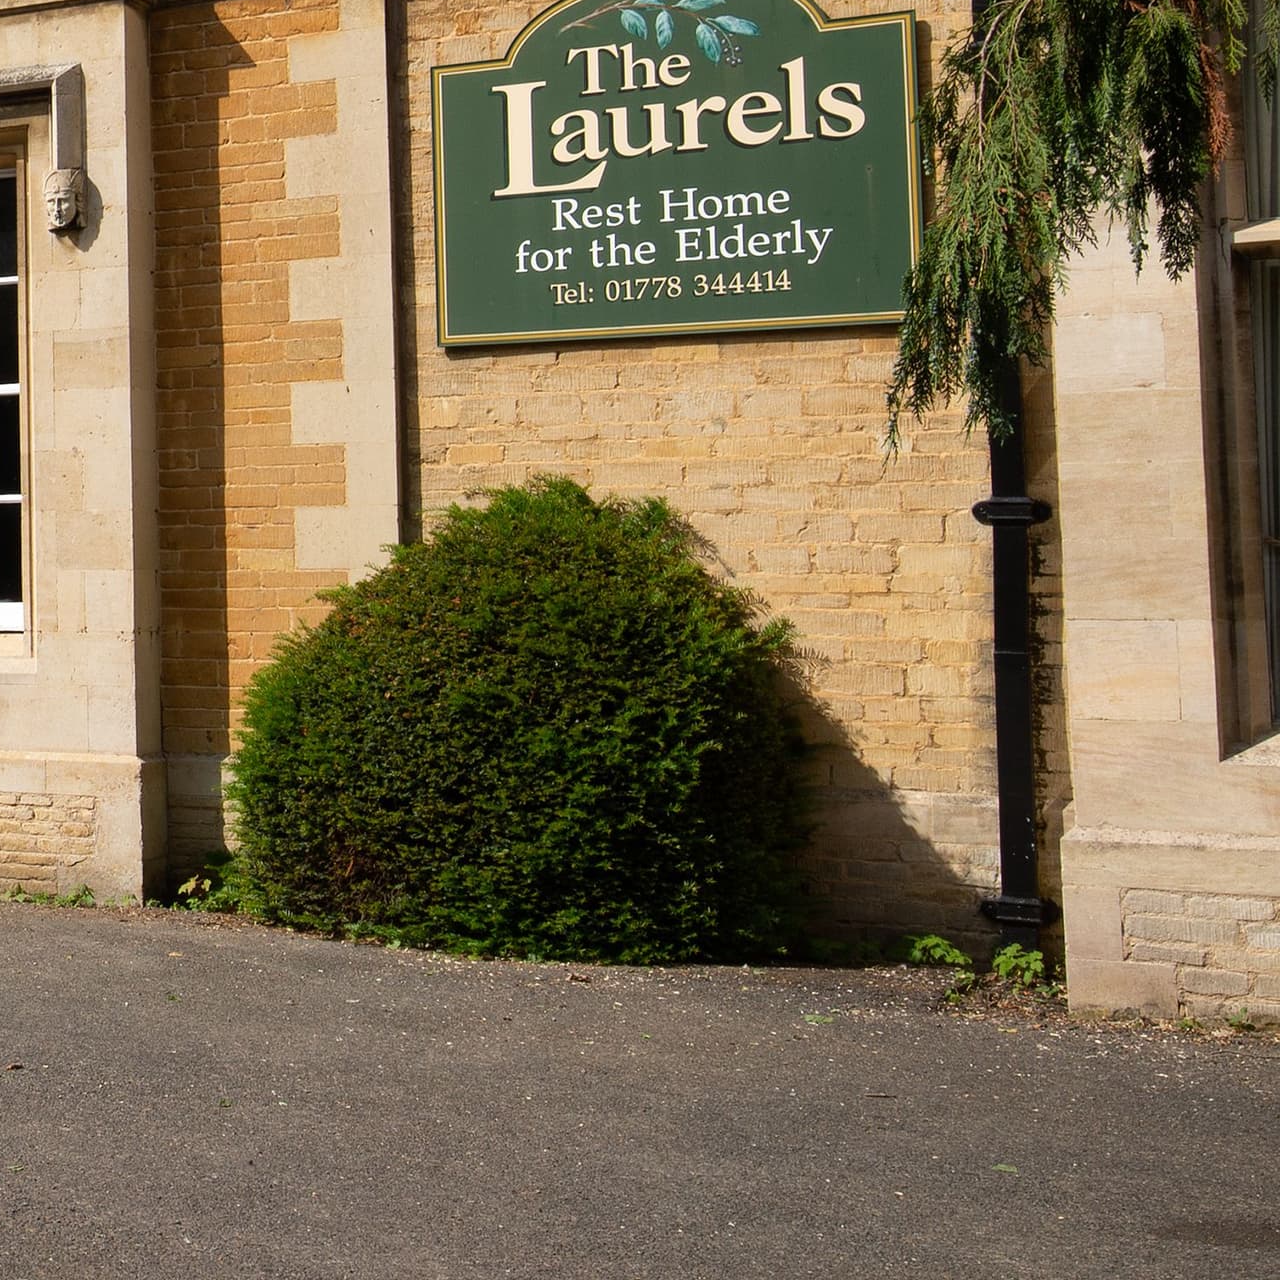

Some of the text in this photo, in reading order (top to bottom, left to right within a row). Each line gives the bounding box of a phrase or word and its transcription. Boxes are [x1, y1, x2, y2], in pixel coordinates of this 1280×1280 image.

[567, 42, 691, 95] The
[491, 56, 867, 197] Laurels
[551, 187, 790, 231] Rest Home
[515, 219, 834, 273] for the Elderly
[550, 269, 792, 305] Tel: 01778 344414
